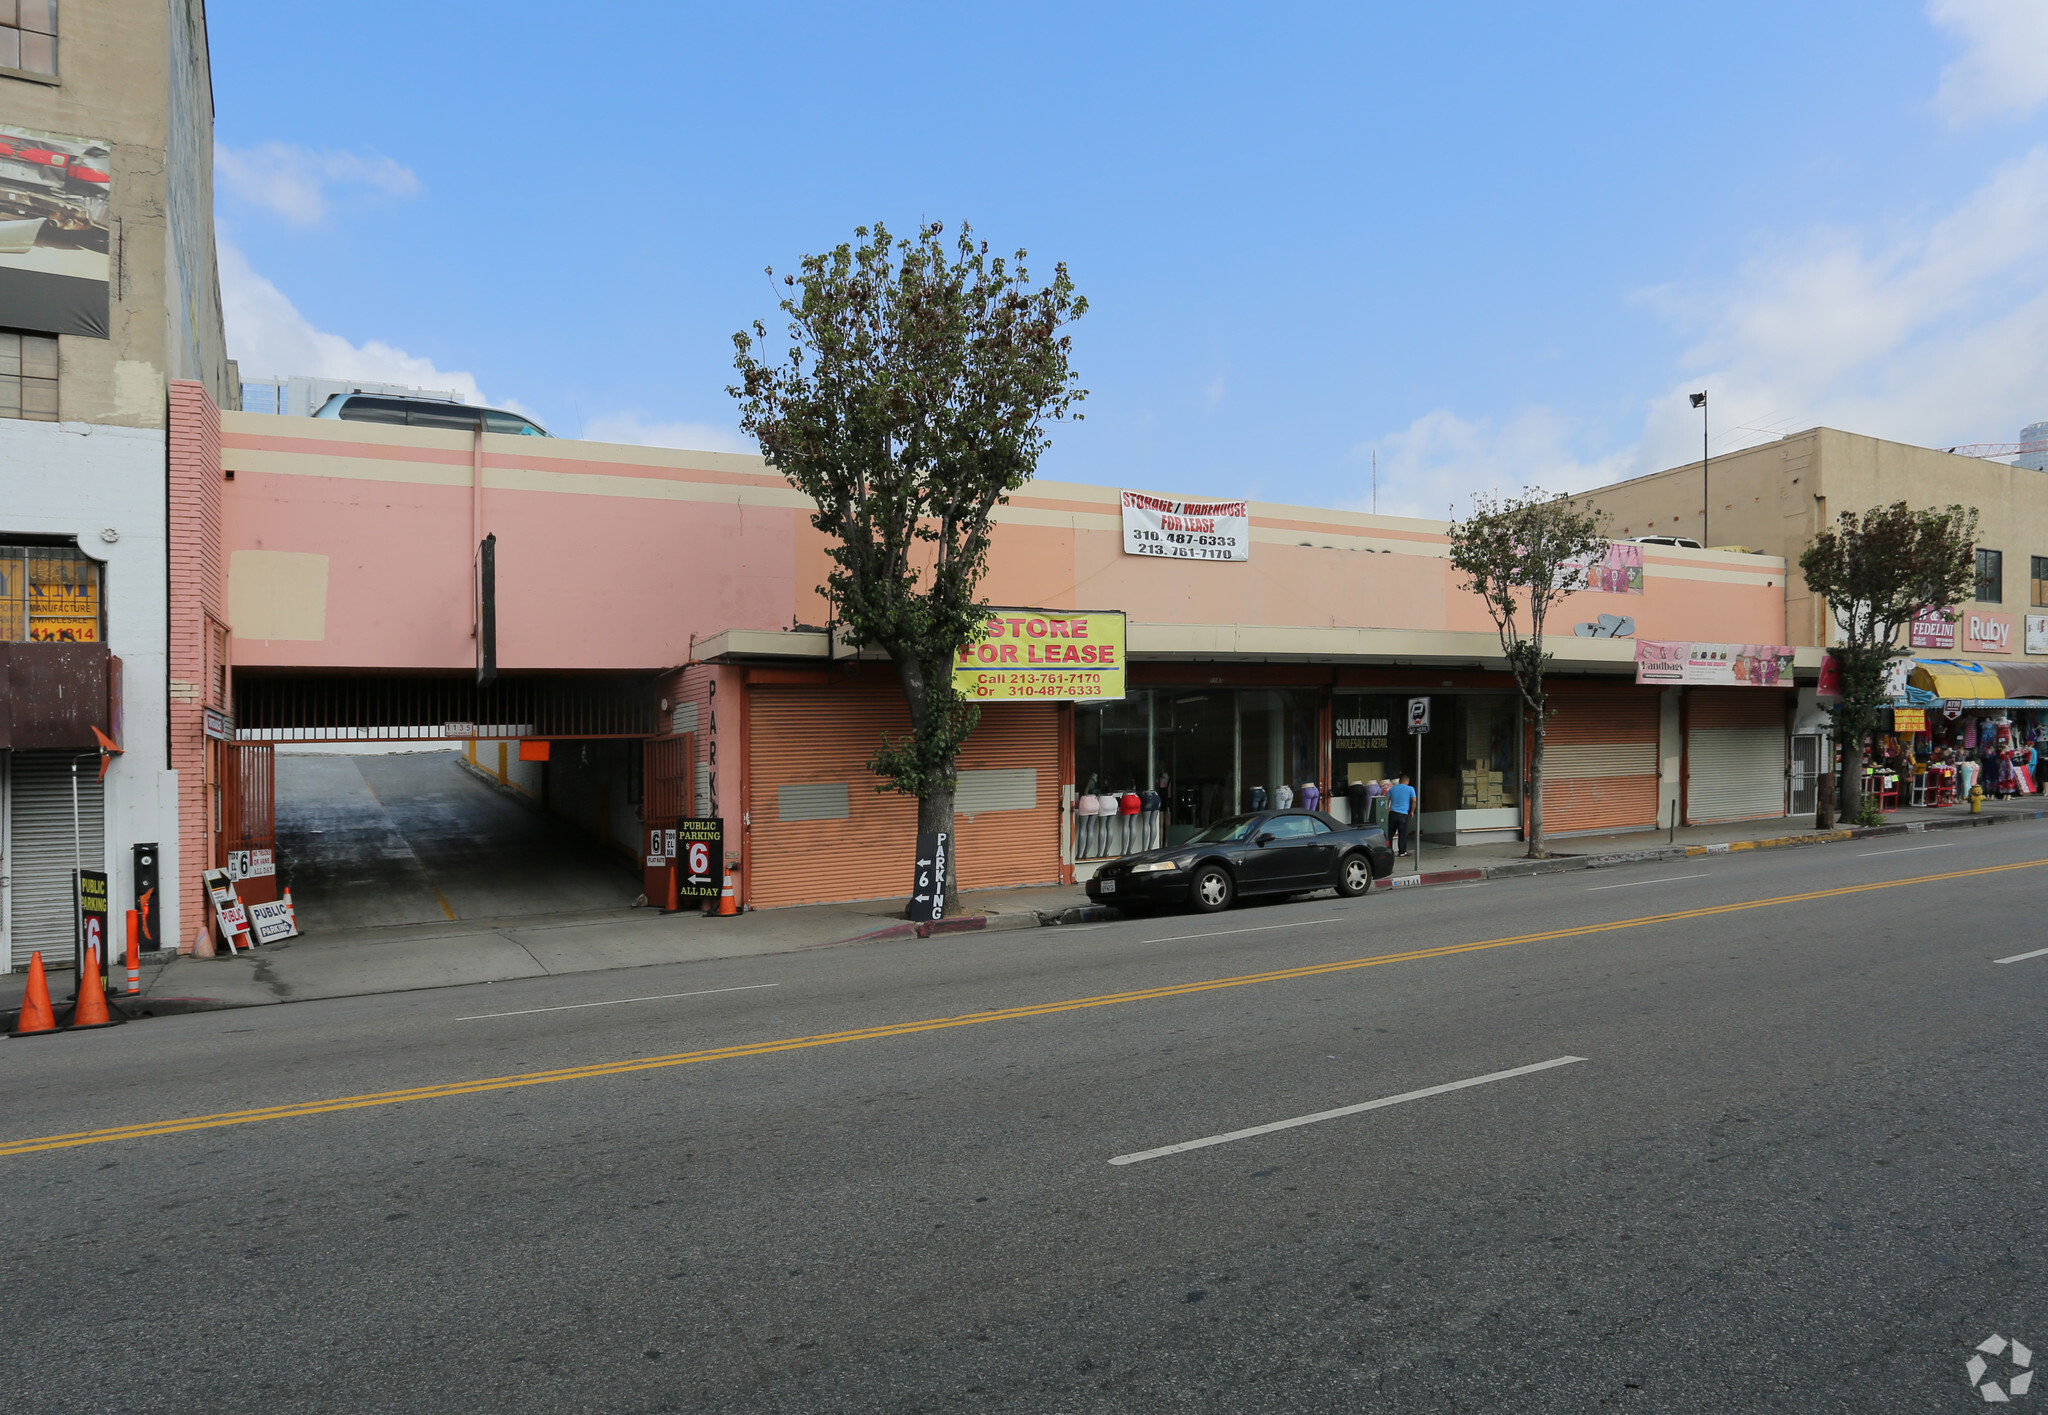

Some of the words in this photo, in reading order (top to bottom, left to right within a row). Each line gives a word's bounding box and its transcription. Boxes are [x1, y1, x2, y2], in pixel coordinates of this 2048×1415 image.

[1123, 492, 1173, 513] STORAGE
[1183, 502, 1246, 517] WAREHOUSE
[1161, 514, 1182, 531] FOR
[1185, 517, 1214, 533] LEASE
[1166, 533, 1236, 546] 487-6333
[1172, 546, 1232, 559] 761-7170
[30, 604, 91, 612] MANUFACTURE
[986, 617, 1088, 638] STORE
[1913, 622, 1954, 636] FEDELINI
[1969, 616, 2010, 647] Ruby
[959, 644, 1018, 663] FOR
[1028, 644, 1114, 663] LEASE
[977, 674, 1005, 684] Call
[1010, 673, 1100, 684] 213-761-7170
[976, 686, 995, 696] Or
[1008, 685, 1101, 696] 310-487-6333
[1335, 718, 1388, 737] SILVERLAND
[1335, 738, 1366, 749] WHOLESALE
[1371, 738, 1388, 749] RETAIL
[683, 821, 716, 831] PUBLIC
[652, 833, 660, 851] 6
[679, 831, 721, 840] PARKING
[667, 840, 674, 848] EL
[231, 862, 237, 871] EL
[240, 853, 248, 875] 6
[918, 871, 929, 888] 6
[931, 832, 947, 920] PARKING
[81, 878, 105, 895] PUBLIC
[680, 887, 698, 896] ALL
[700, 887, 719, 897] DAY
[81, 895, 107, 912] PARKING
[222, 908, 244, 924] PUBLIC
[253, 904, 287, 920] PUBLIC
[261, 923, 290, 936] PARKING
